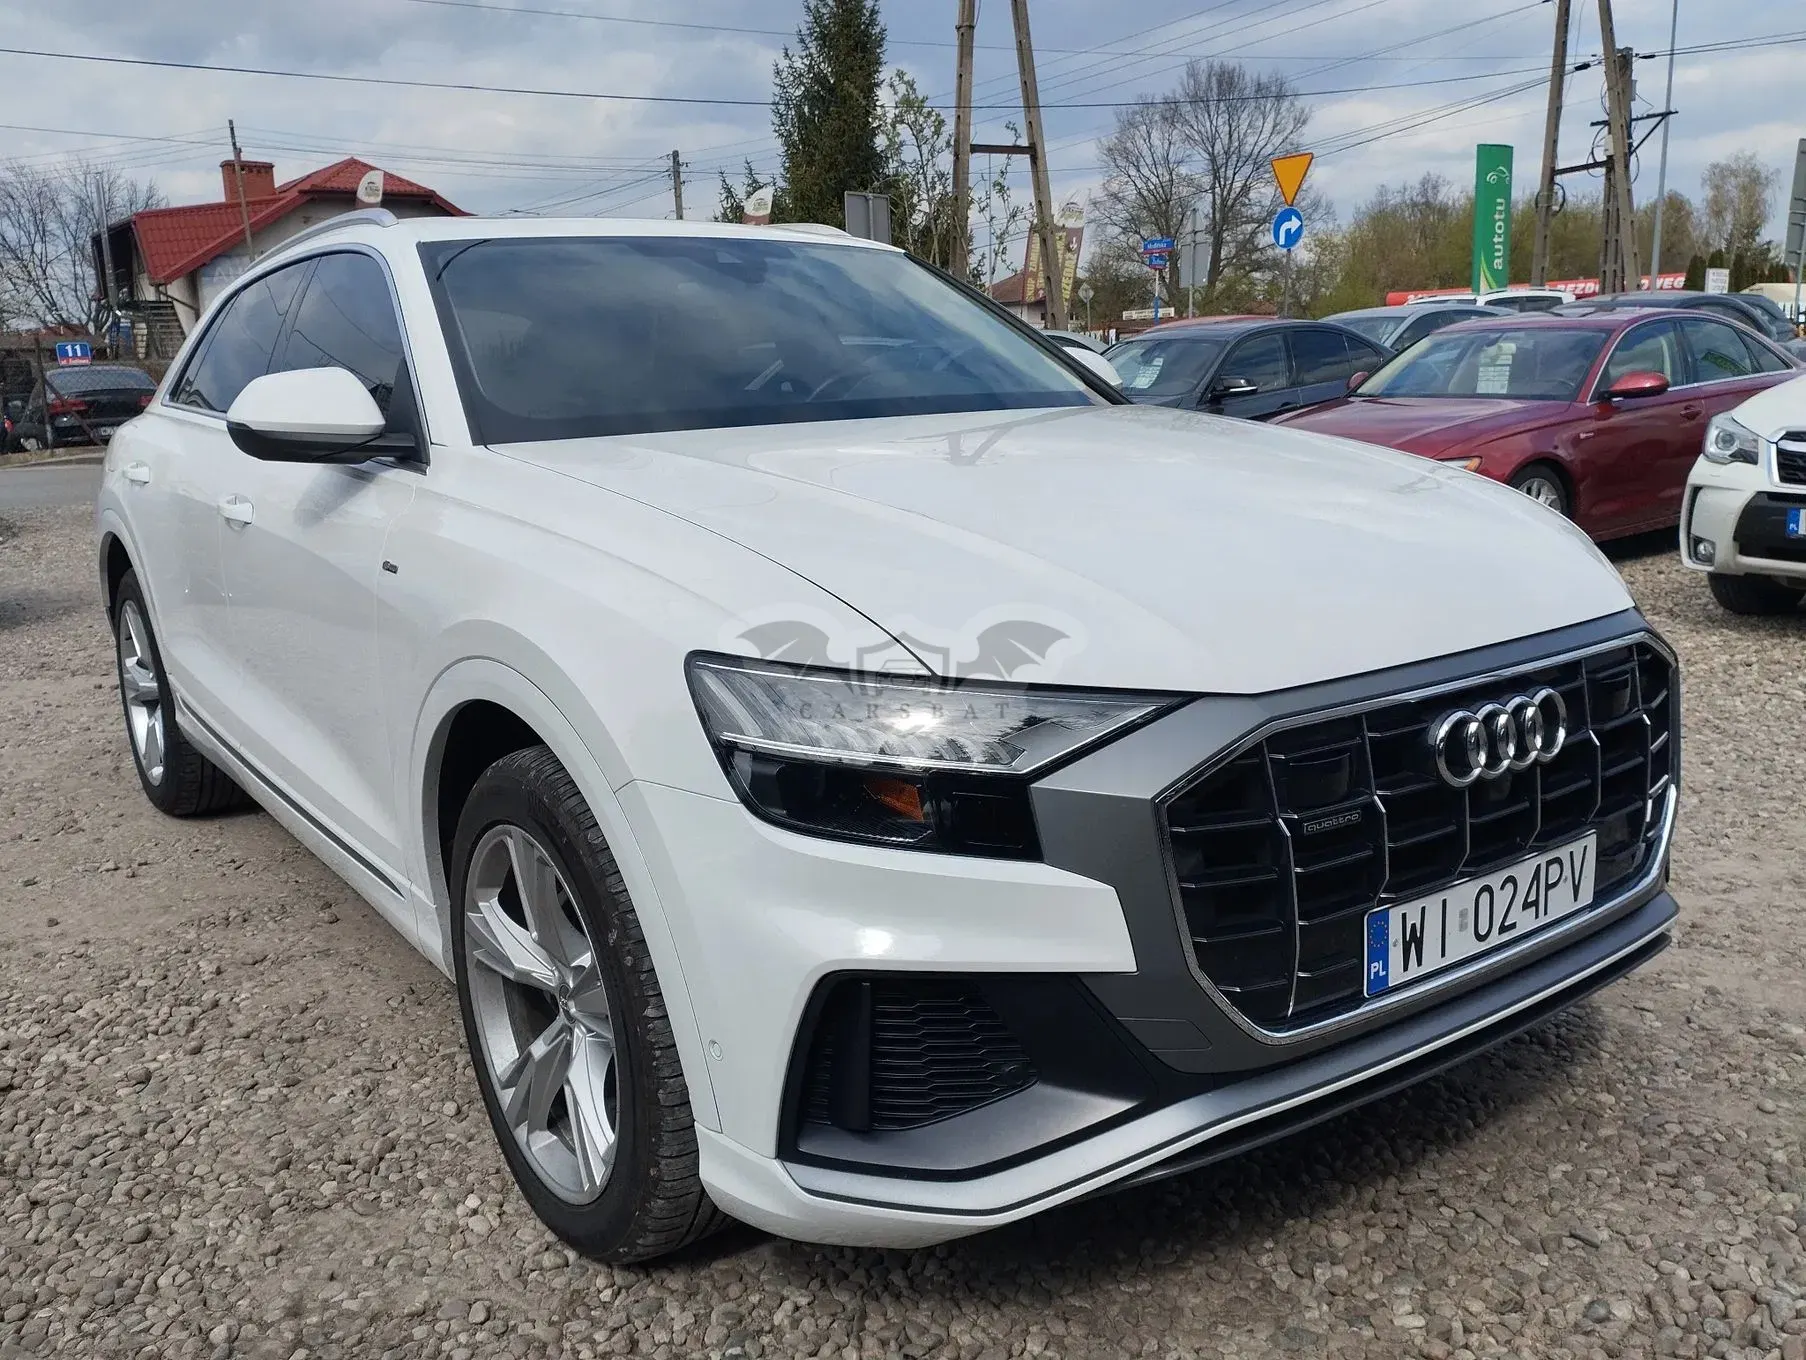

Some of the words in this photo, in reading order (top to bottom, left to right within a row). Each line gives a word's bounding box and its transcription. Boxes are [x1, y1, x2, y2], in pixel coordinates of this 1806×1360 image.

[1493, 199, 1506, 270] autotu
[65, 344, 82, 357] 11
[1307, 813, 1359, 832] quattro
[1474, 845, 1588, 942] 024PV
[1370, 962, 1387, 980] PL
